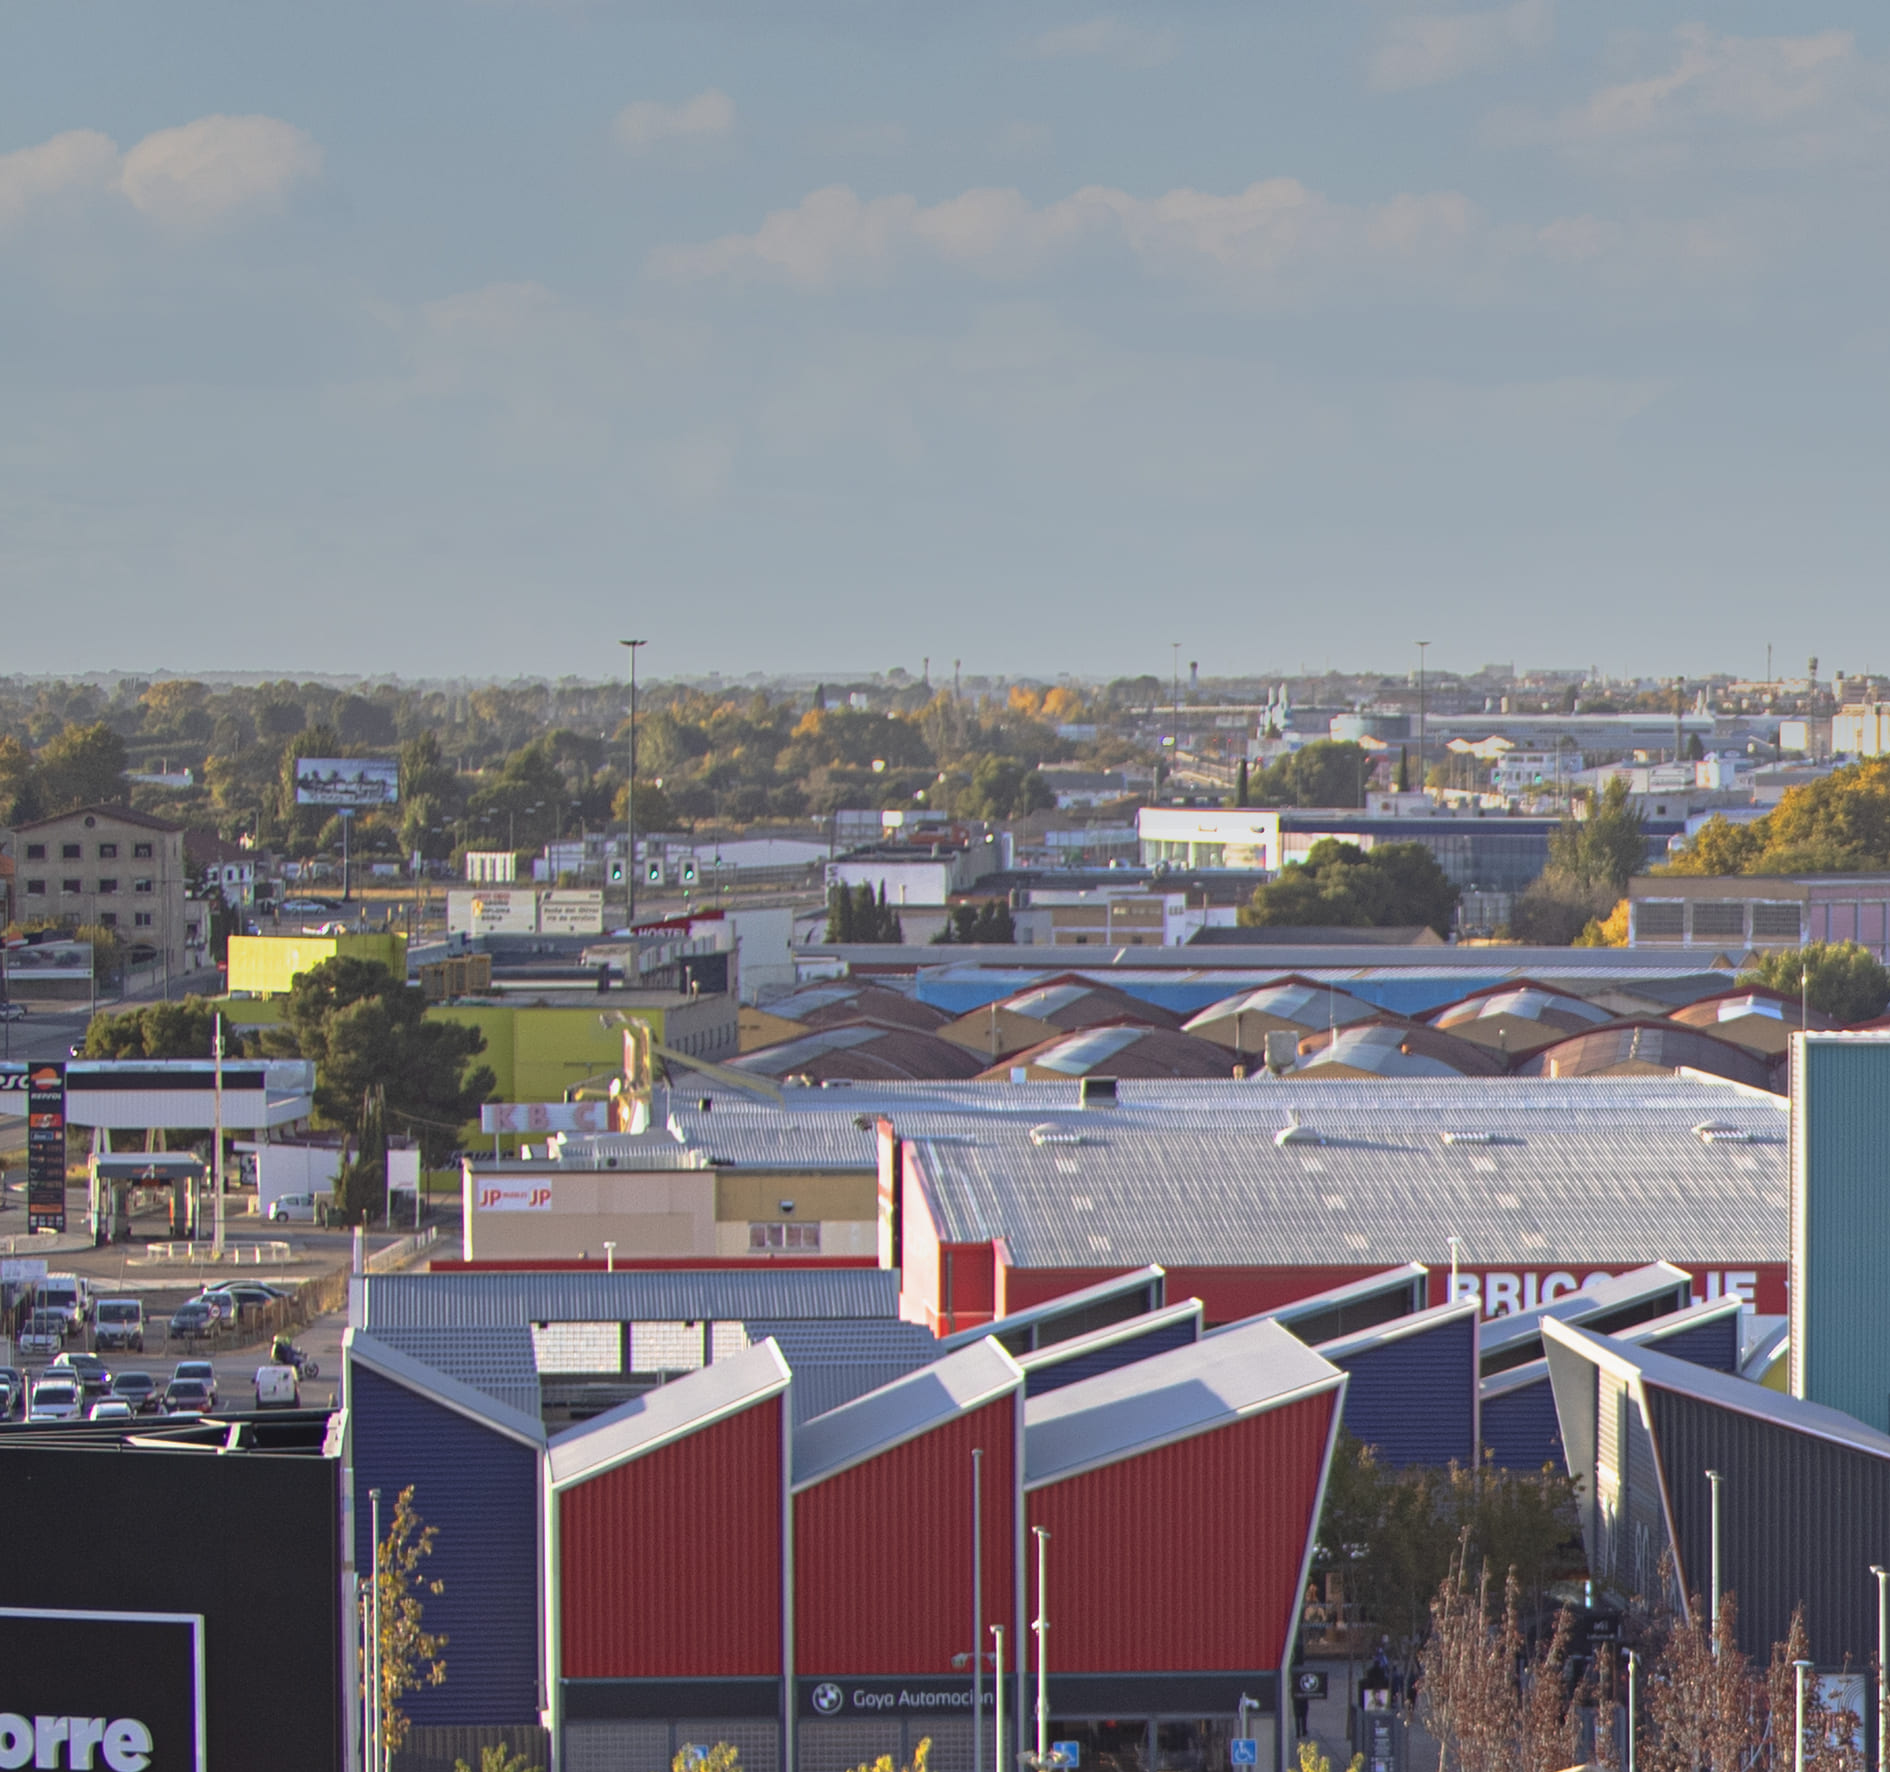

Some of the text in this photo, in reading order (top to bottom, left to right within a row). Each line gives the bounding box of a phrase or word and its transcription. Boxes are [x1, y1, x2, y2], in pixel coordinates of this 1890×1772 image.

[479, 1189, 501, 1207] JP
[529, 1188, 551, 1206] JP
[853, 1690, 895, 1709] Goya
